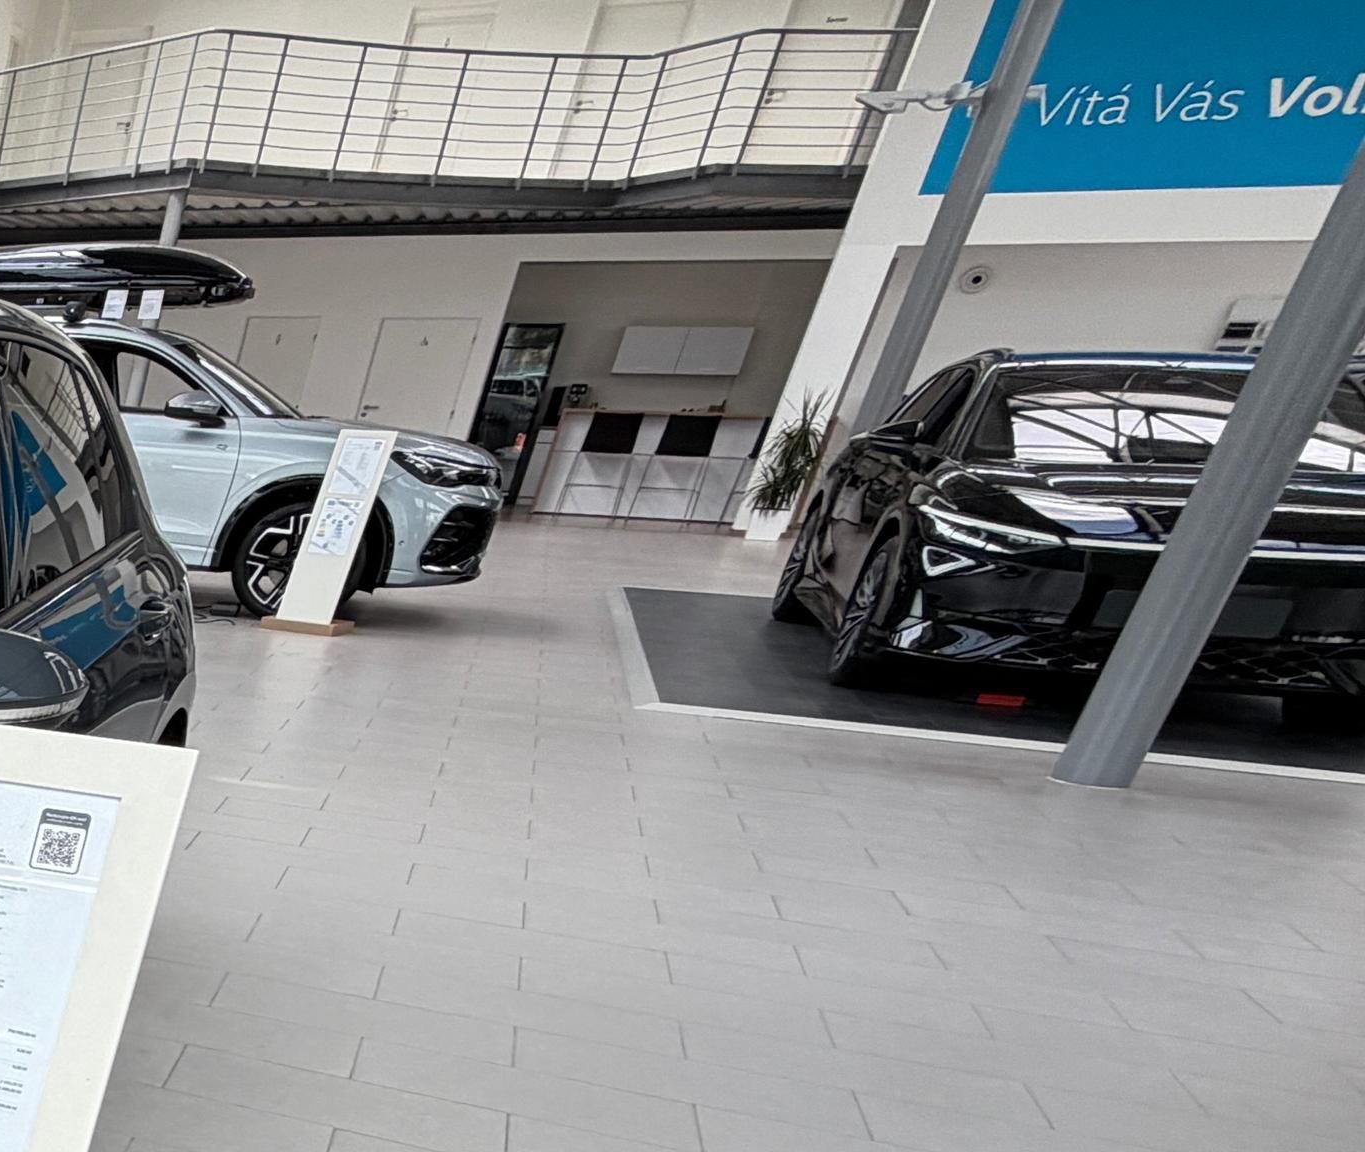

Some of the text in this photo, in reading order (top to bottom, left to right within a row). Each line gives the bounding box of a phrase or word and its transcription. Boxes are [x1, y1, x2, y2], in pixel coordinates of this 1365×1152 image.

[1037, 72, 1365, 127] Vítá Vás Vol
